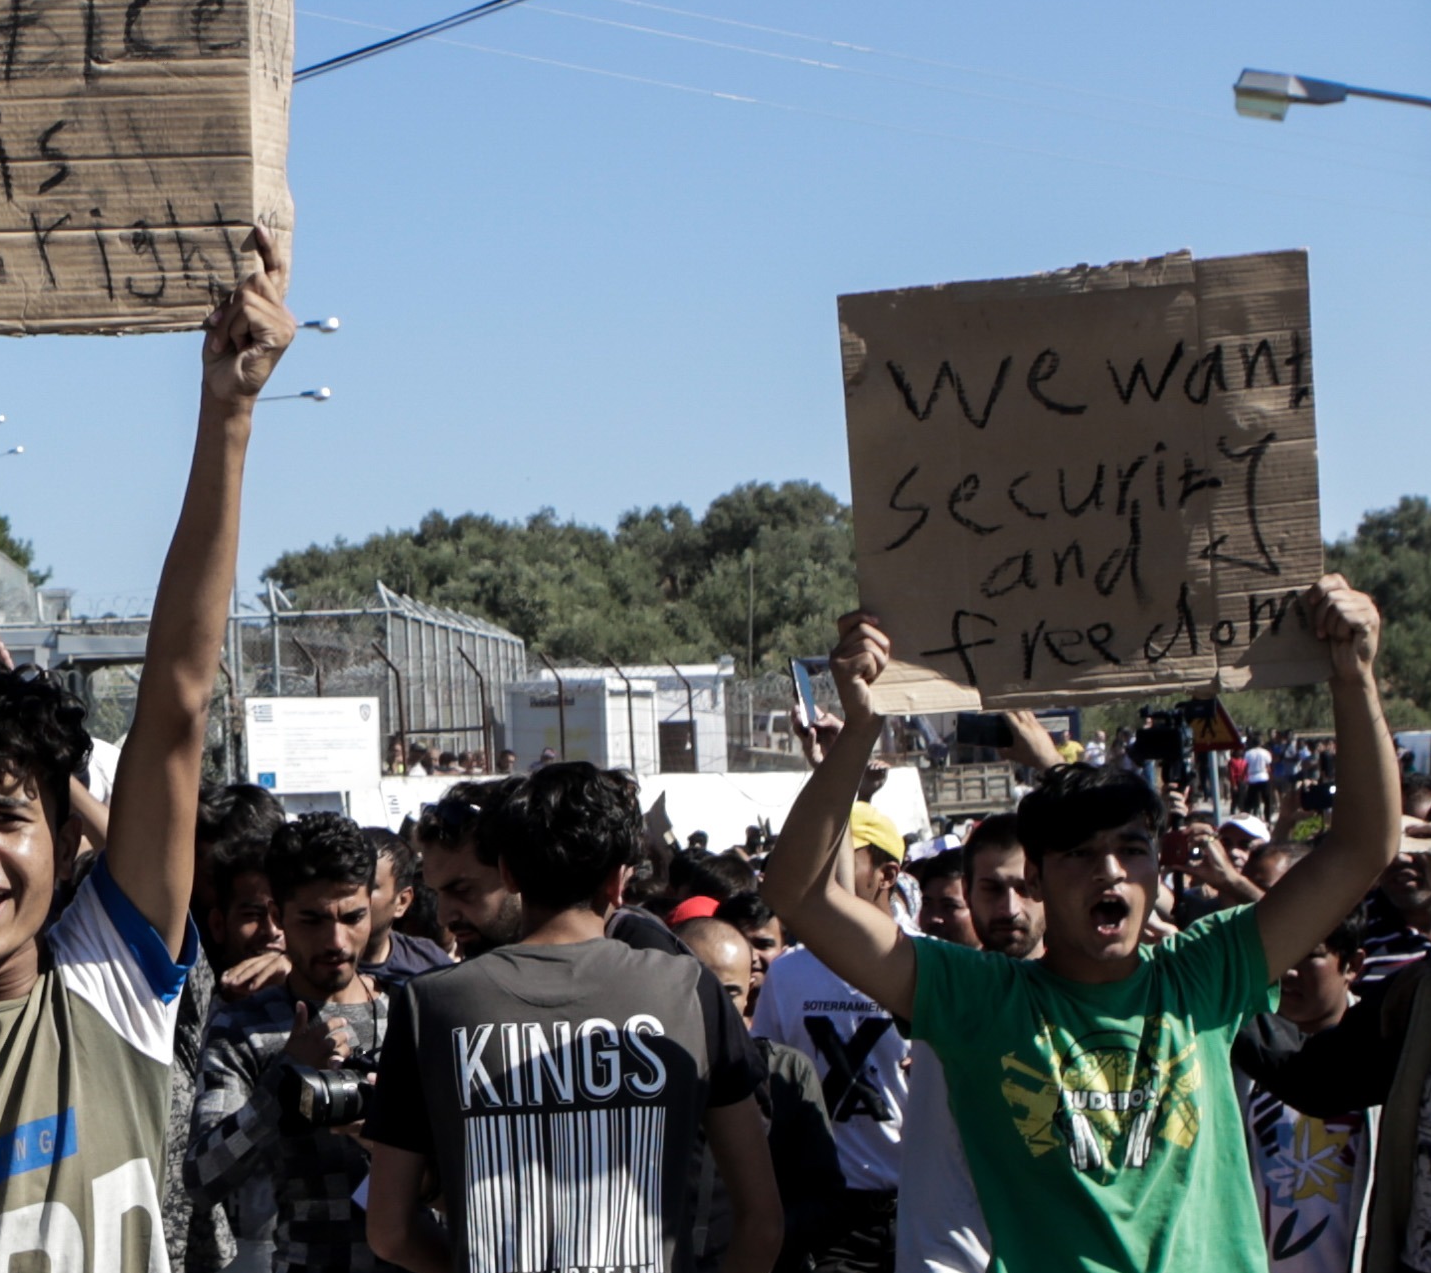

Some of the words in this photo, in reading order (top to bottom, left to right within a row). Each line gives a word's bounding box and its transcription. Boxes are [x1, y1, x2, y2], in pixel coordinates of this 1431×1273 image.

[886, 347, 1087, 429] We
[1105, 331, 1314, 409] want
[884, 431, 1281, 577] security
[979, 499, 1149, 603] and
[920, 582, 1311, 687] freedom
[451, 1013, 668, 1111] KINGS
